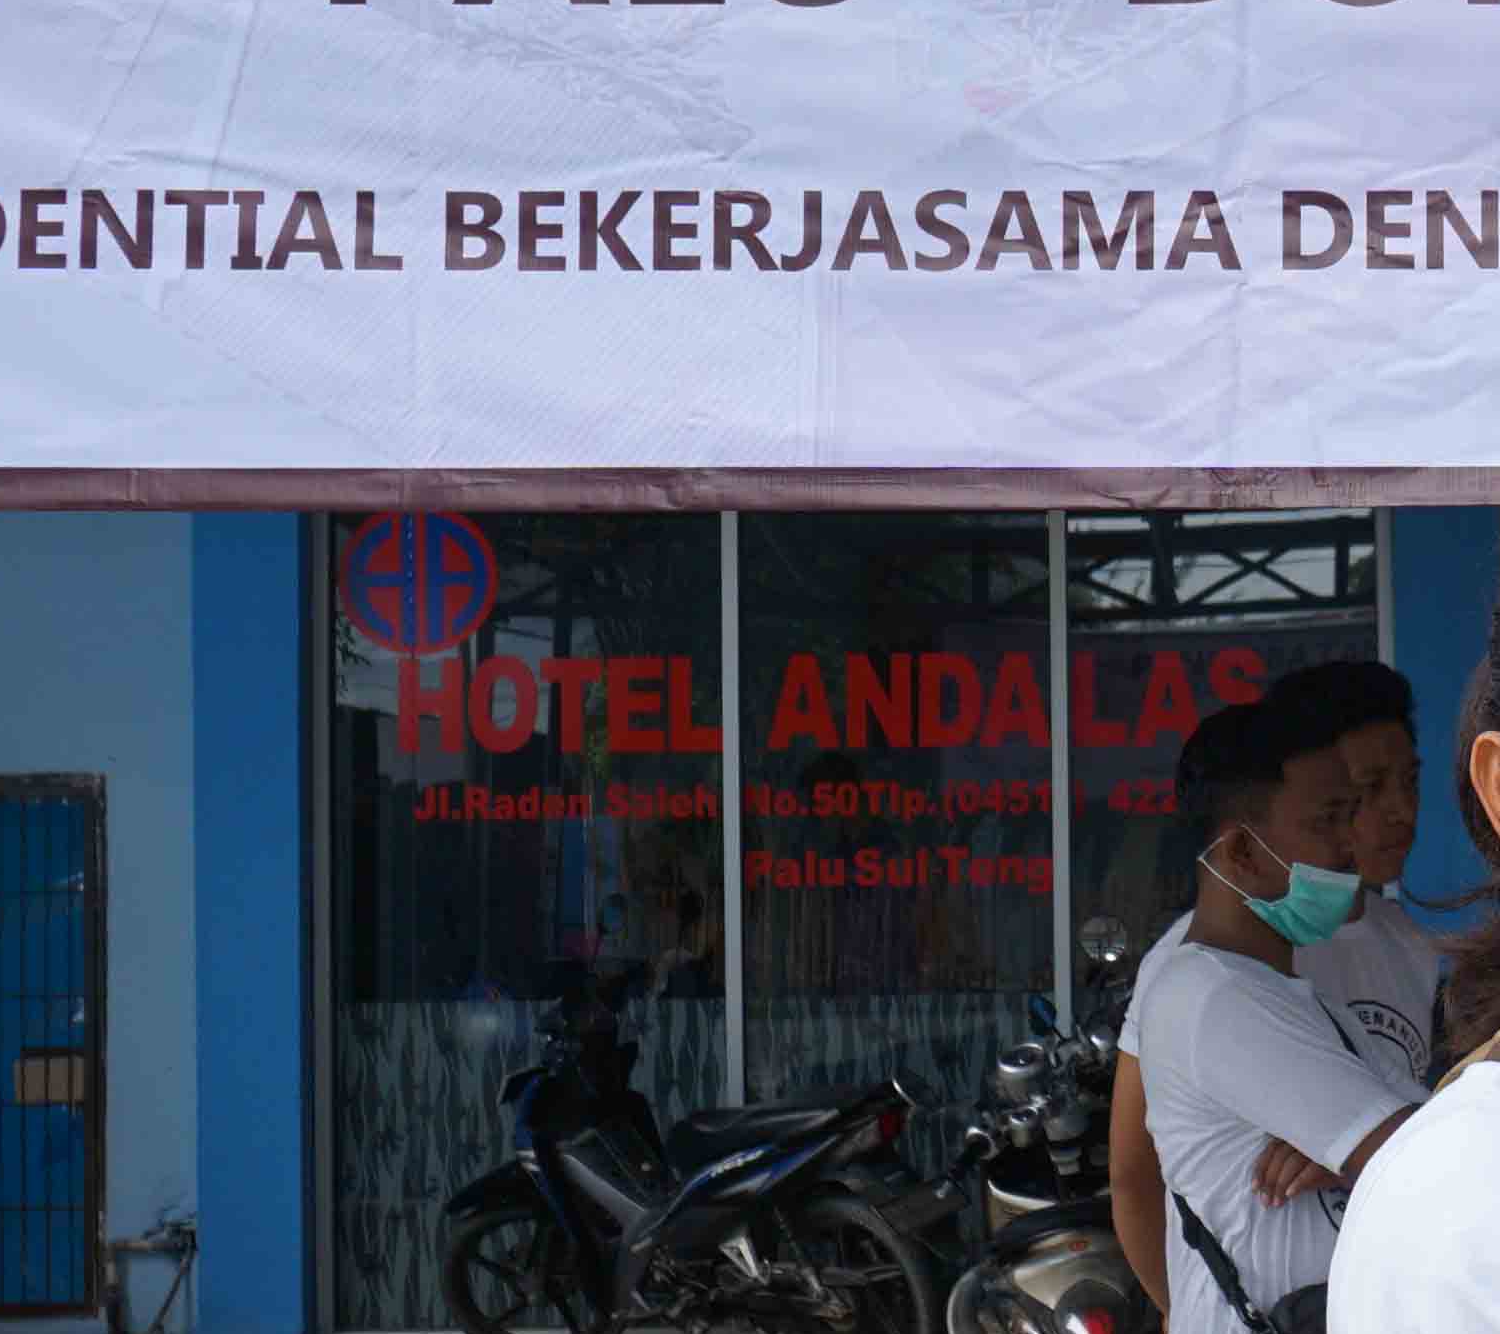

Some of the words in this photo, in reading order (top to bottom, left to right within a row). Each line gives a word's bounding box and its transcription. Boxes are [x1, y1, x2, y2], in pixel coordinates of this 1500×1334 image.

[446, 190, 1241, 271] BEKERJASAMA
[396, 654, 724, 754] HOTEL
[767, 648, 1268, 749] ANDALAS
[742, 847, 847, 892] Palu
